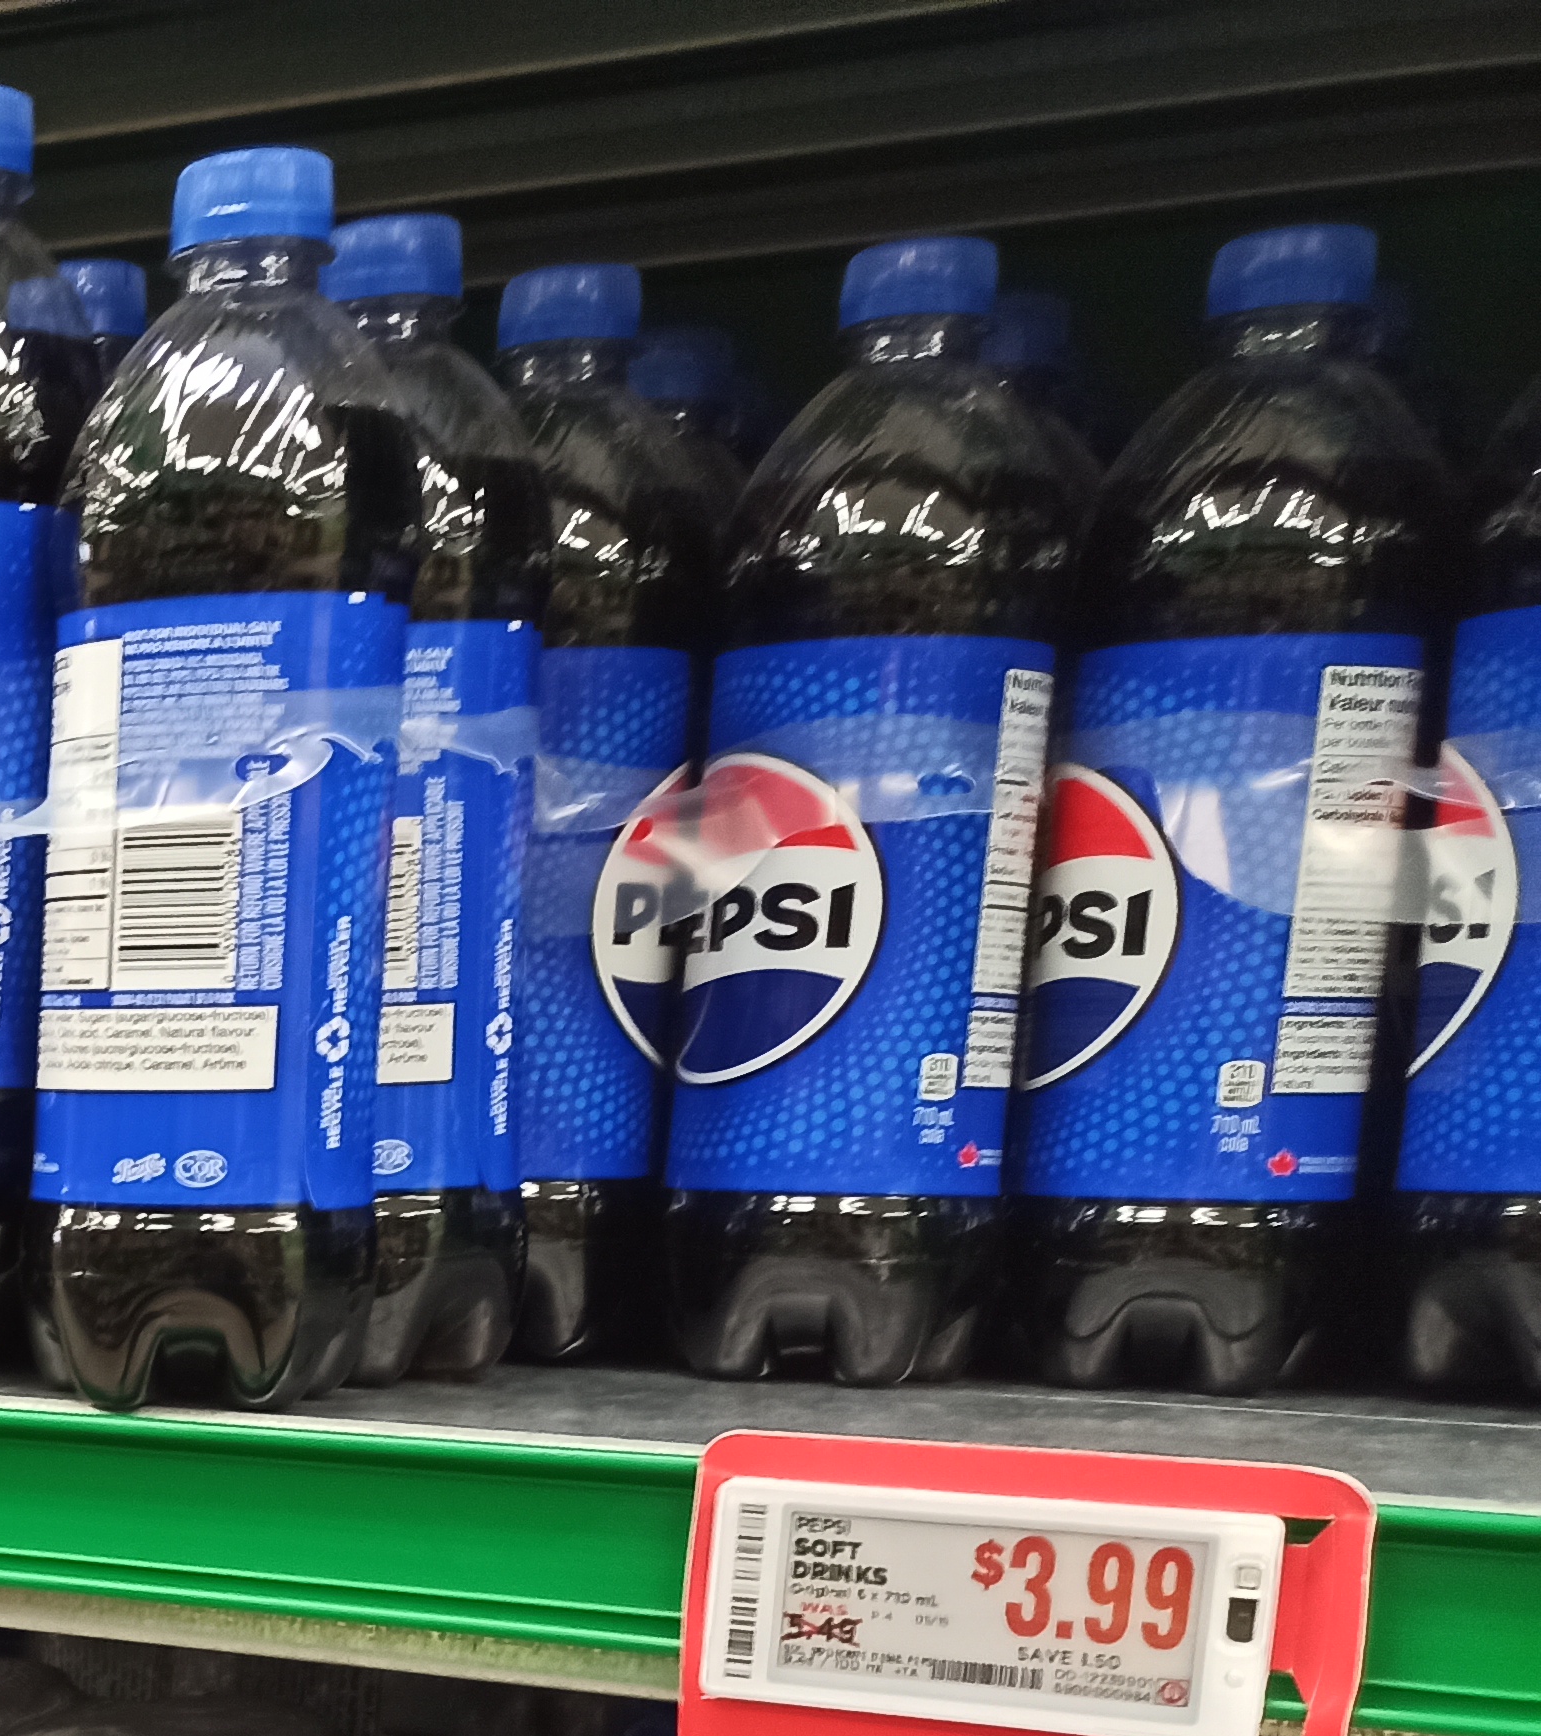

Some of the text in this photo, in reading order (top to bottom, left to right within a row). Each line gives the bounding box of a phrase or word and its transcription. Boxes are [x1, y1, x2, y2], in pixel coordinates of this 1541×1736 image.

[1034, 889, 1153, 959] PSI
[793, 1537, 863, 1560] SOFT
[790, 1560, 889, 1587] DRINKS
[971, 1534, 1195, 1651] $3.99
[1017, 1645, 1072, 1666] SAVE
